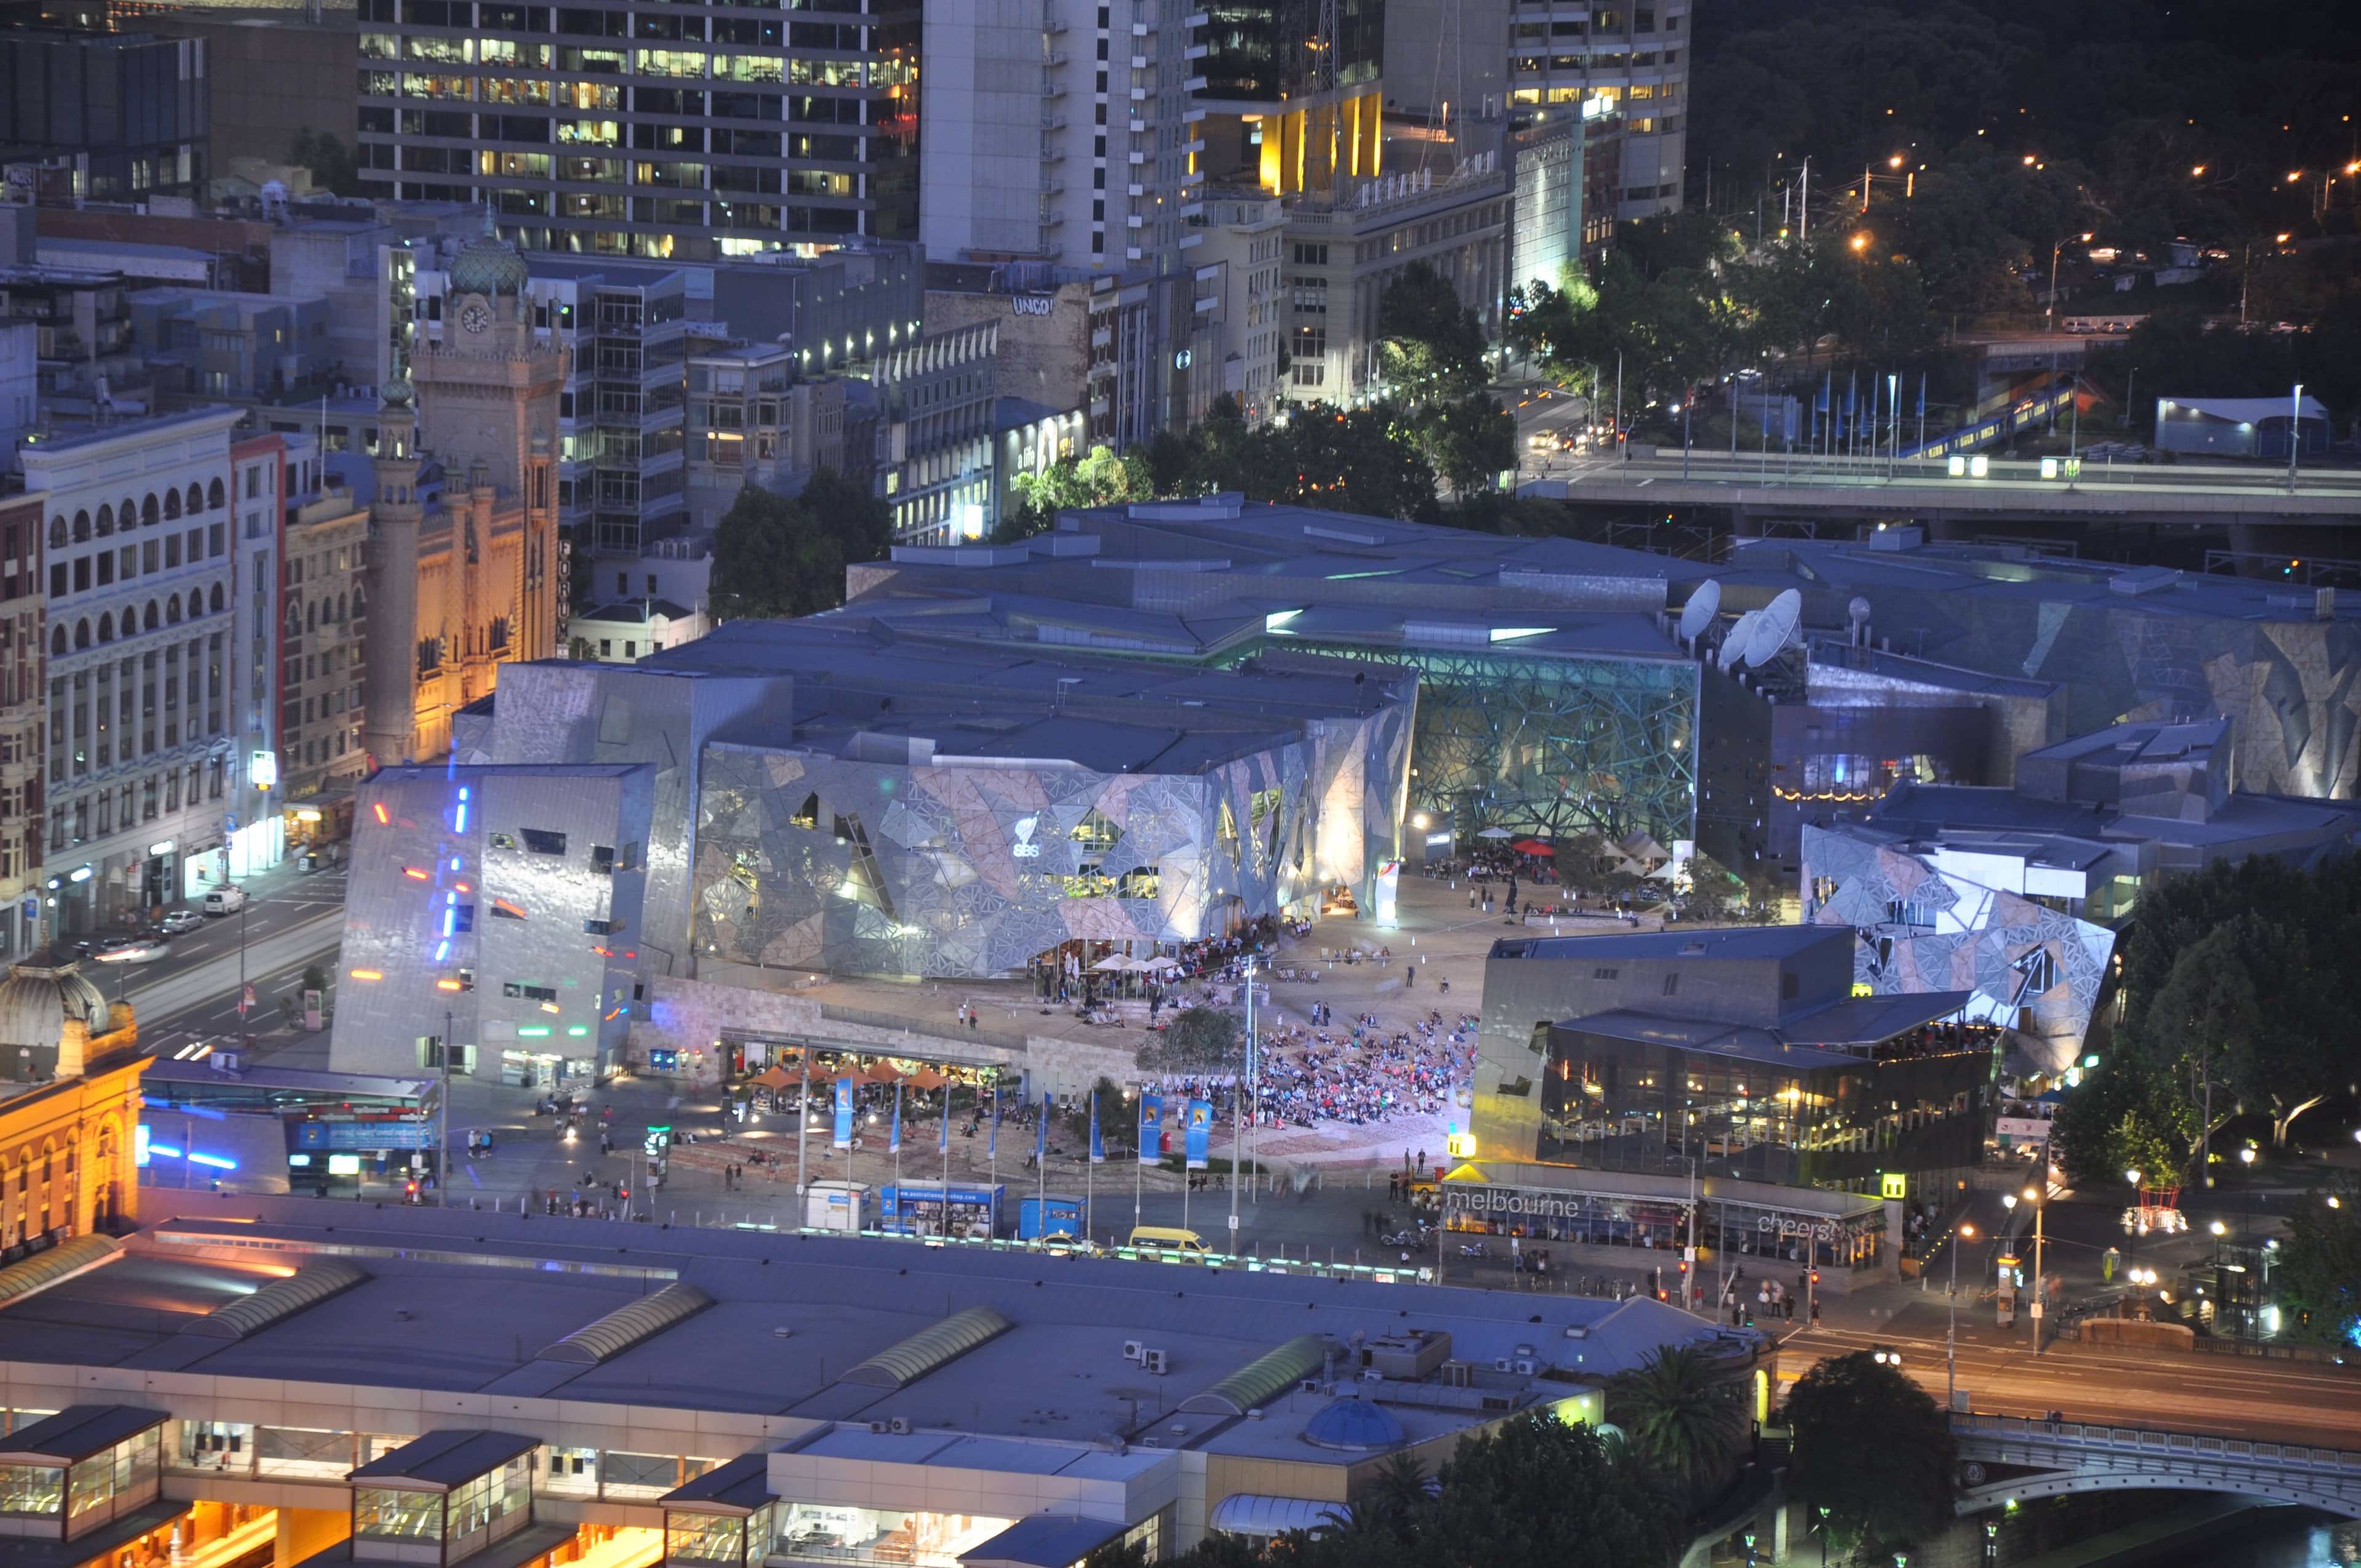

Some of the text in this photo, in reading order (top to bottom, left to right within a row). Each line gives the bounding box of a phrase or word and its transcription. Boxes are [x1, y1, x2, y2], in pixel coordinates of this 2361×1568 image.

[1018, 445, 1035, 469] a life
[560, 541, 570, 637] FORUM
[1013, 844, 1039, 857] SBS
[1447, 1189, 1579, 1218] melbourne
[1757, 1212, 1835, 1241] cheers!
